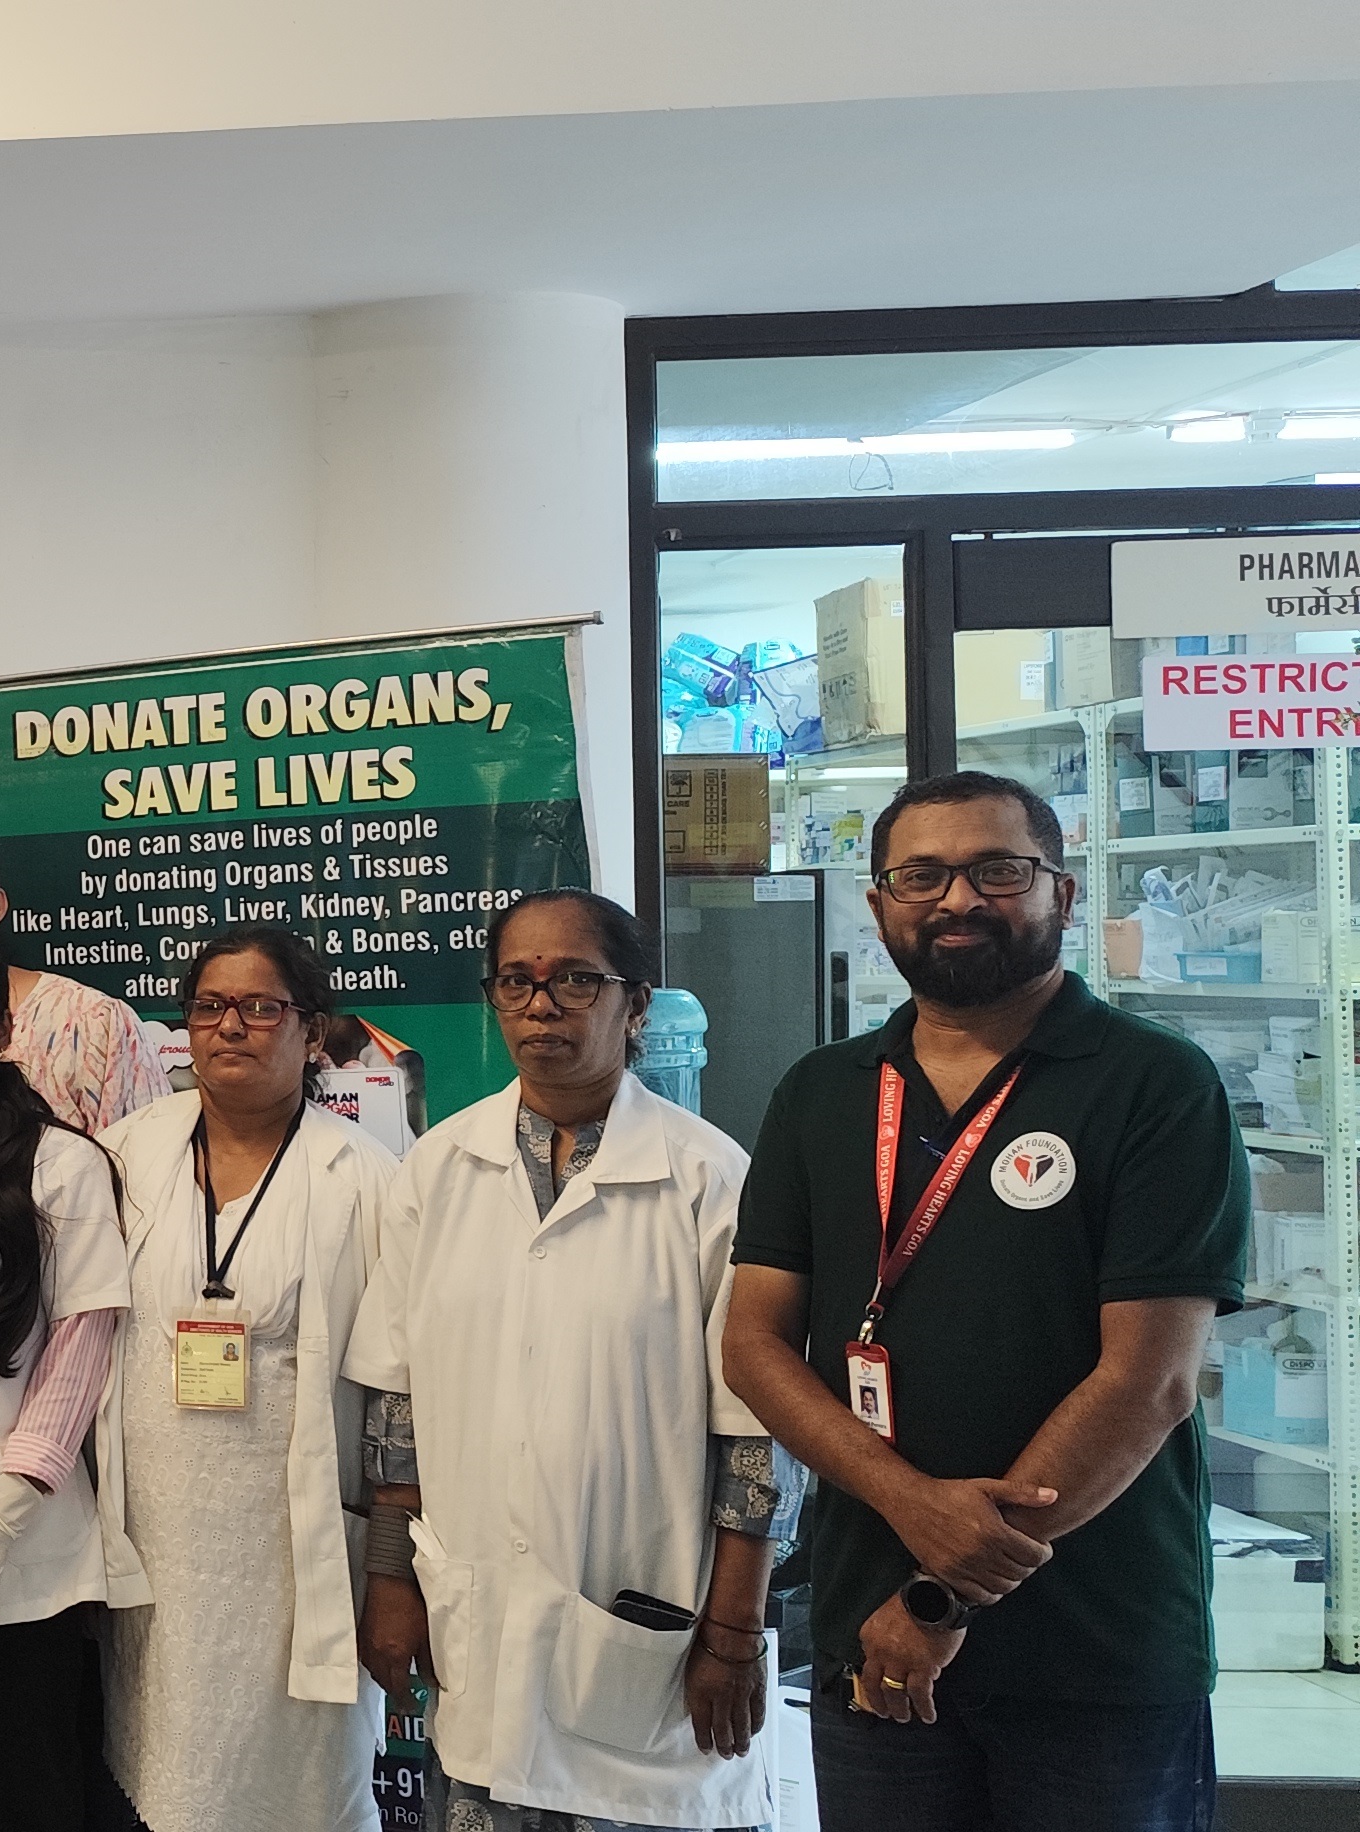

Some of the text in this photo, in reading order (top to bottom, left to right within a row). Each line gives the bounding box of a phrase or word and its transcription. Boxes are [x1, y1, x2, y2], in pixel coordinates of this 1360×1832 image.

[1239, 550, 1360, 582] PHARMA
[15, 667, 513, 760] DONATE ORGANS,
[103, 745, 417, 820] SAVE LIVES
[86, 813, 438, 860] One can save lives of people
[80, 853, 450, 899] by donating Organs & Tissues
[11, 888, 524, 933] like Heart, Lungs, Liver, Kidney, Pancreas
[44, 939, 151, 966] Intestine,
[325, 929, 344, 955] &
[352, 927, 439, 955] Bones,
[124, 964, 407, 998] after death.
[340, 1092, 359, 1103] AN
[882, 1081, 897, 1123] LOVING
[975, 1106, 996, 1129] GOA
[880, 1144, 891, 1169] GOA
[998, 1138, 1068, 1174] MOHAN FOUNDATION
[902, 1149, 971, 1258] LOVING HEARTS GOA
